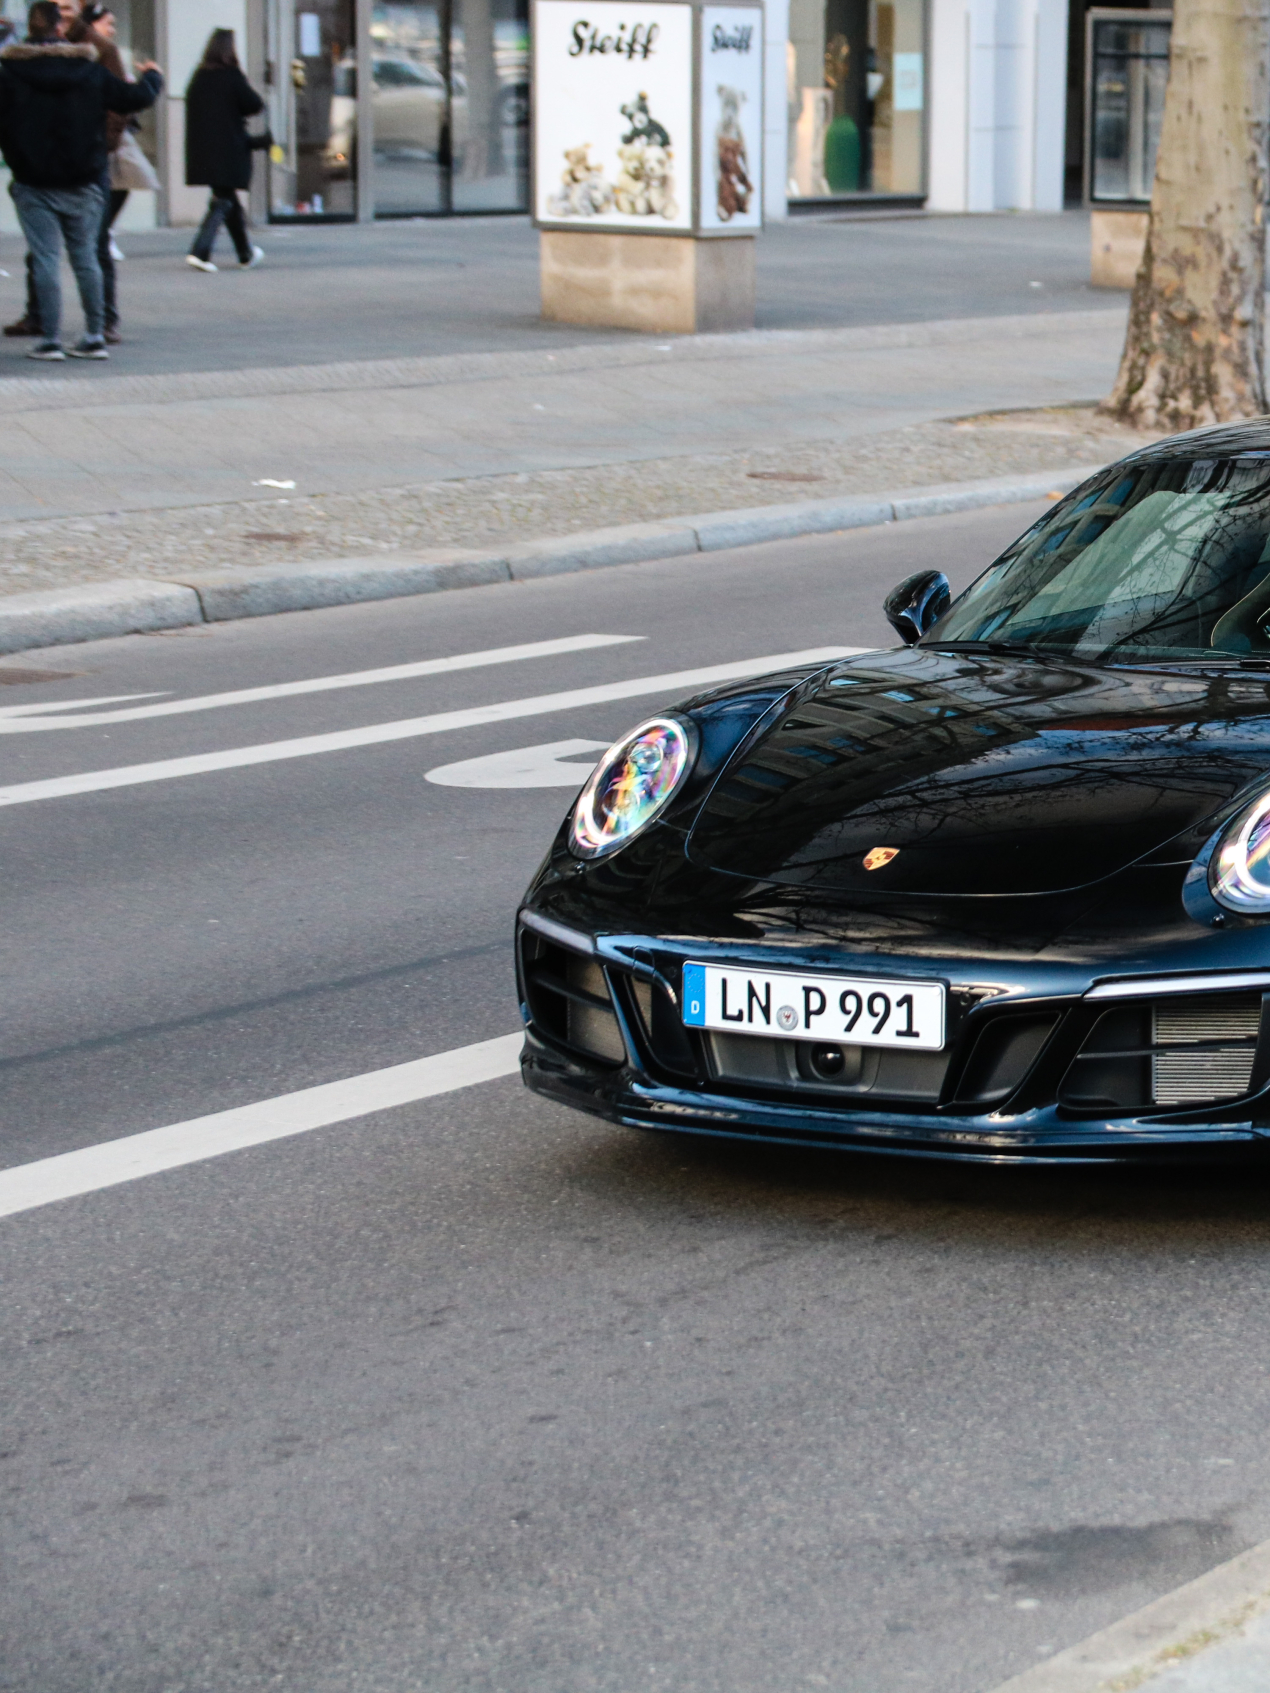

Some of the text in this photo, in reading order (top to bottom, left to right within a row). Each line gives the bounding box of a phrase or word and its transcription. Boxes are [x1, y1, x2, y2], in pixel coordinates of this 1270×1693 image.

[568, 20, 661, 61] Steiff
[711, 24, 754, 54] Steiff
[690, 1000, 701, 1015] D
[721, 977, 921, 1039] LN P 991
